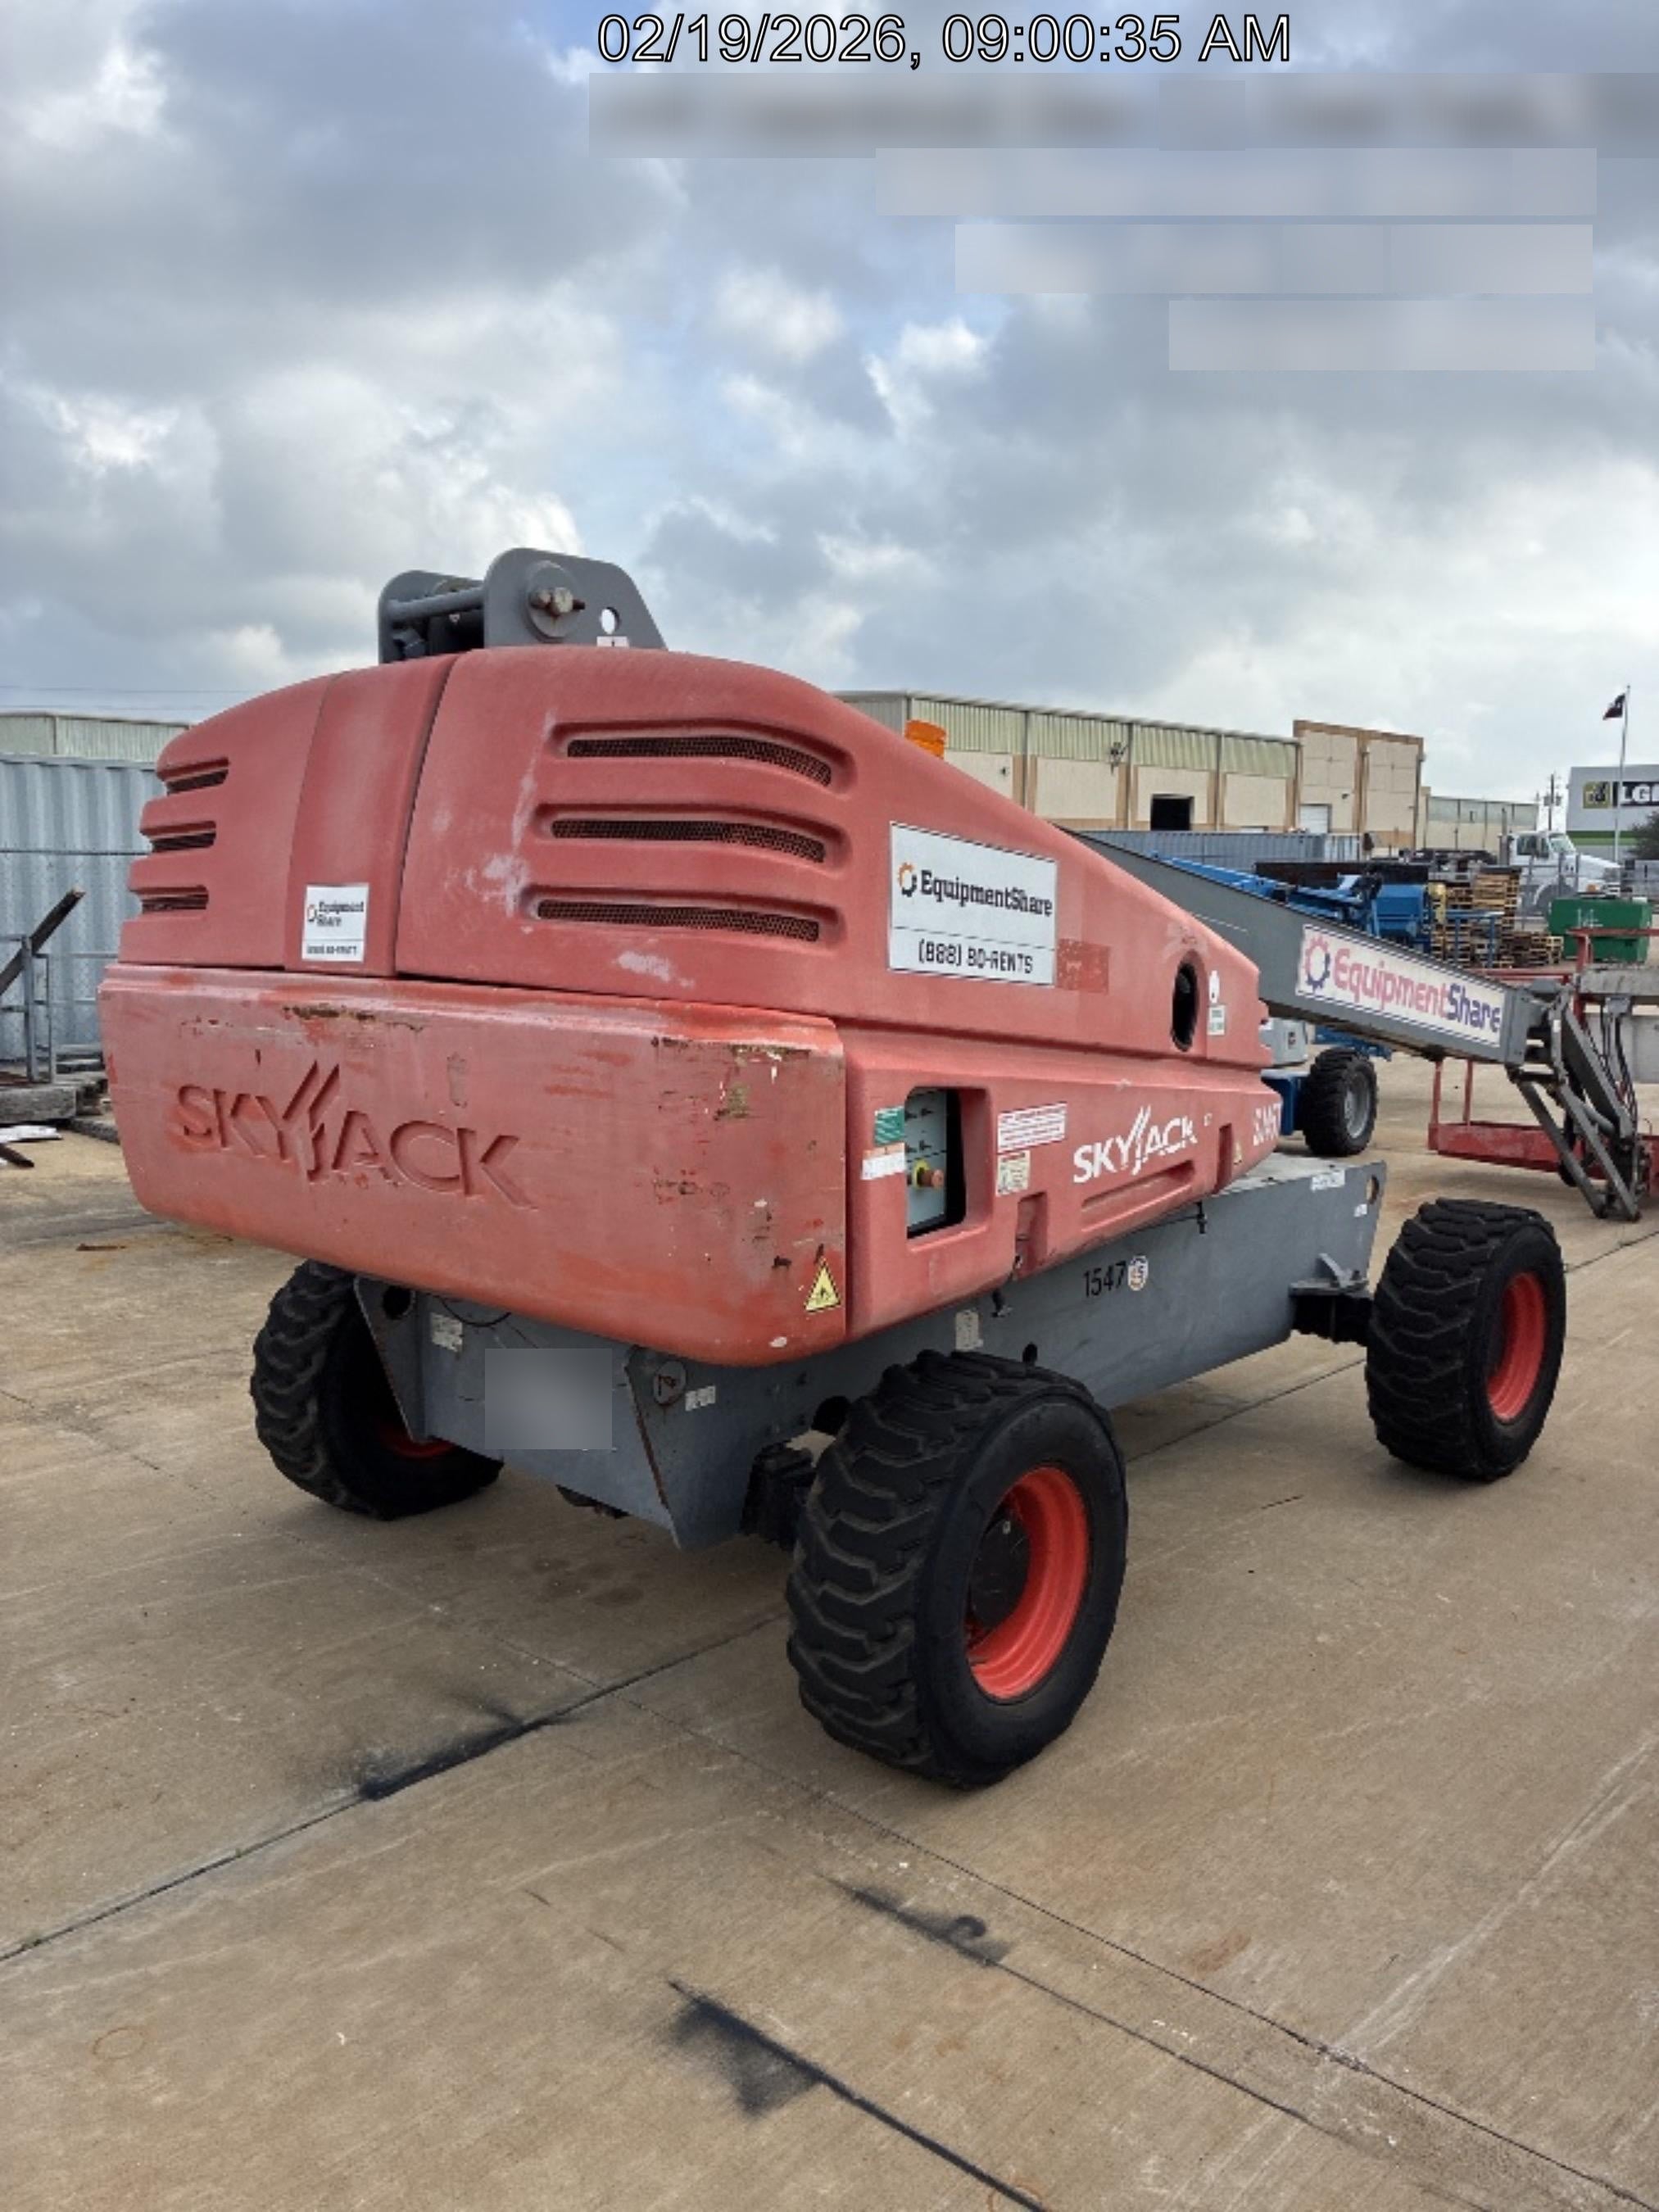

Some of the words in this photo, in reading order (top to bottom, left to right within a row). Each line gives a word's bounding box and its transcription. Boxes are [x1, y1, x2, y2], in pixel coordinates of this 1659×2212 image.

[920, 869, 1053, 917] EquipmentShare
[1332, 948, 1501, 1032] EquipmentShare
[177, 1059, 538, 1210] SKYJACK
[1072, 1105, 1198, 1183] SKYJACK
[1083, 1261, 1127, 1299] 1547
